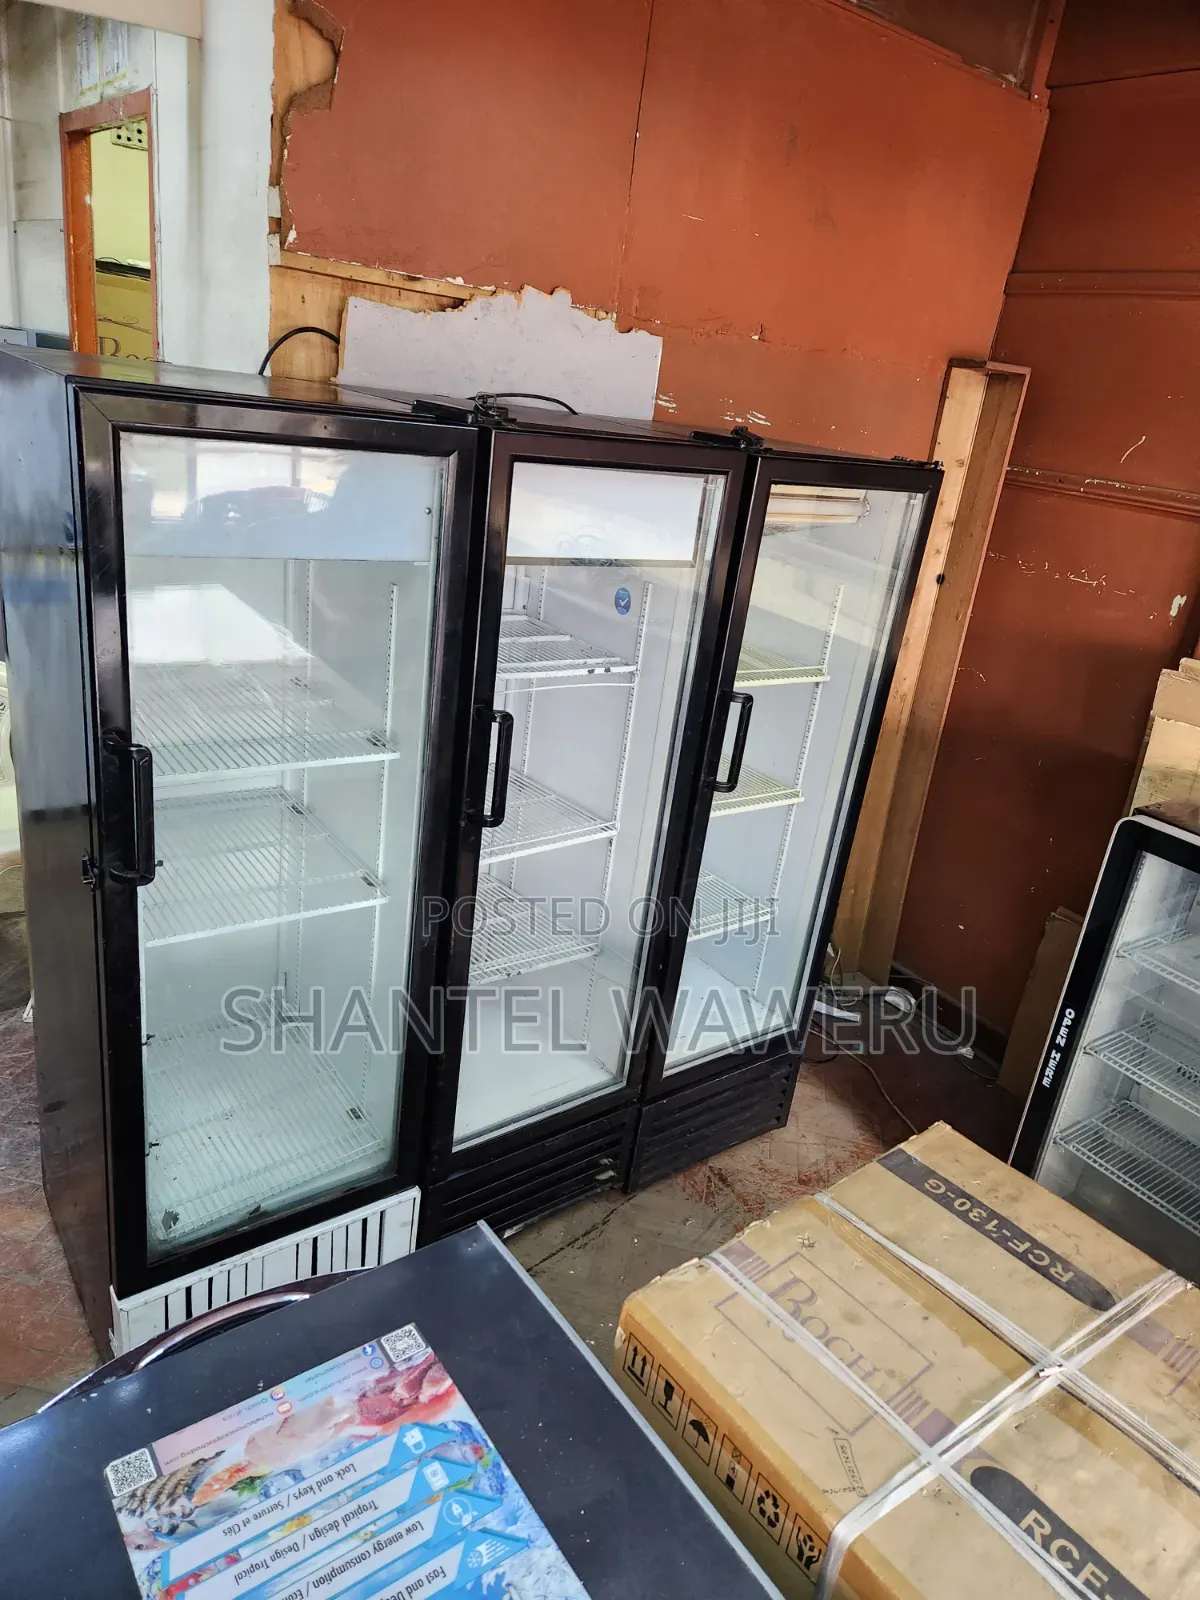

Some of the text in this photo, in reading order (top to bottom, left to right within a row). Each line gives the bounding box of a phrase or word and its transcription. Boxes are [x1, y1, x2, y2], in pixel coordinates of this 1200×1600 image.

[1042, 1008, 1075, 1088] OPEN HERE
[924, 1178, 1075, 1283] RCF-130-G
[316, 1475, 334, 1489] and
[336, 1463, 357, 1480] Lock
[293, 1488, 317, 1501] keys
[253, 1500, 285, 1521] Serrure
[342, 1500, 379, 1527] Tropical
[222, 1523, 241, 1537] Clés
[242, 1518, 251, 1528] et
[309, 1519, 340, 1541] design
[405, 1520, 424, 1536] Low
[270, 1541, 300, 1562] Design
[373, 1531, 403, 1555] energy
[234, 1559, 270, 1586] Tropical
[312, 1551, 371, 1588] consumption
[425, 1565, 447, 1584] Fast
[405, 1578, 424, 1599] and
